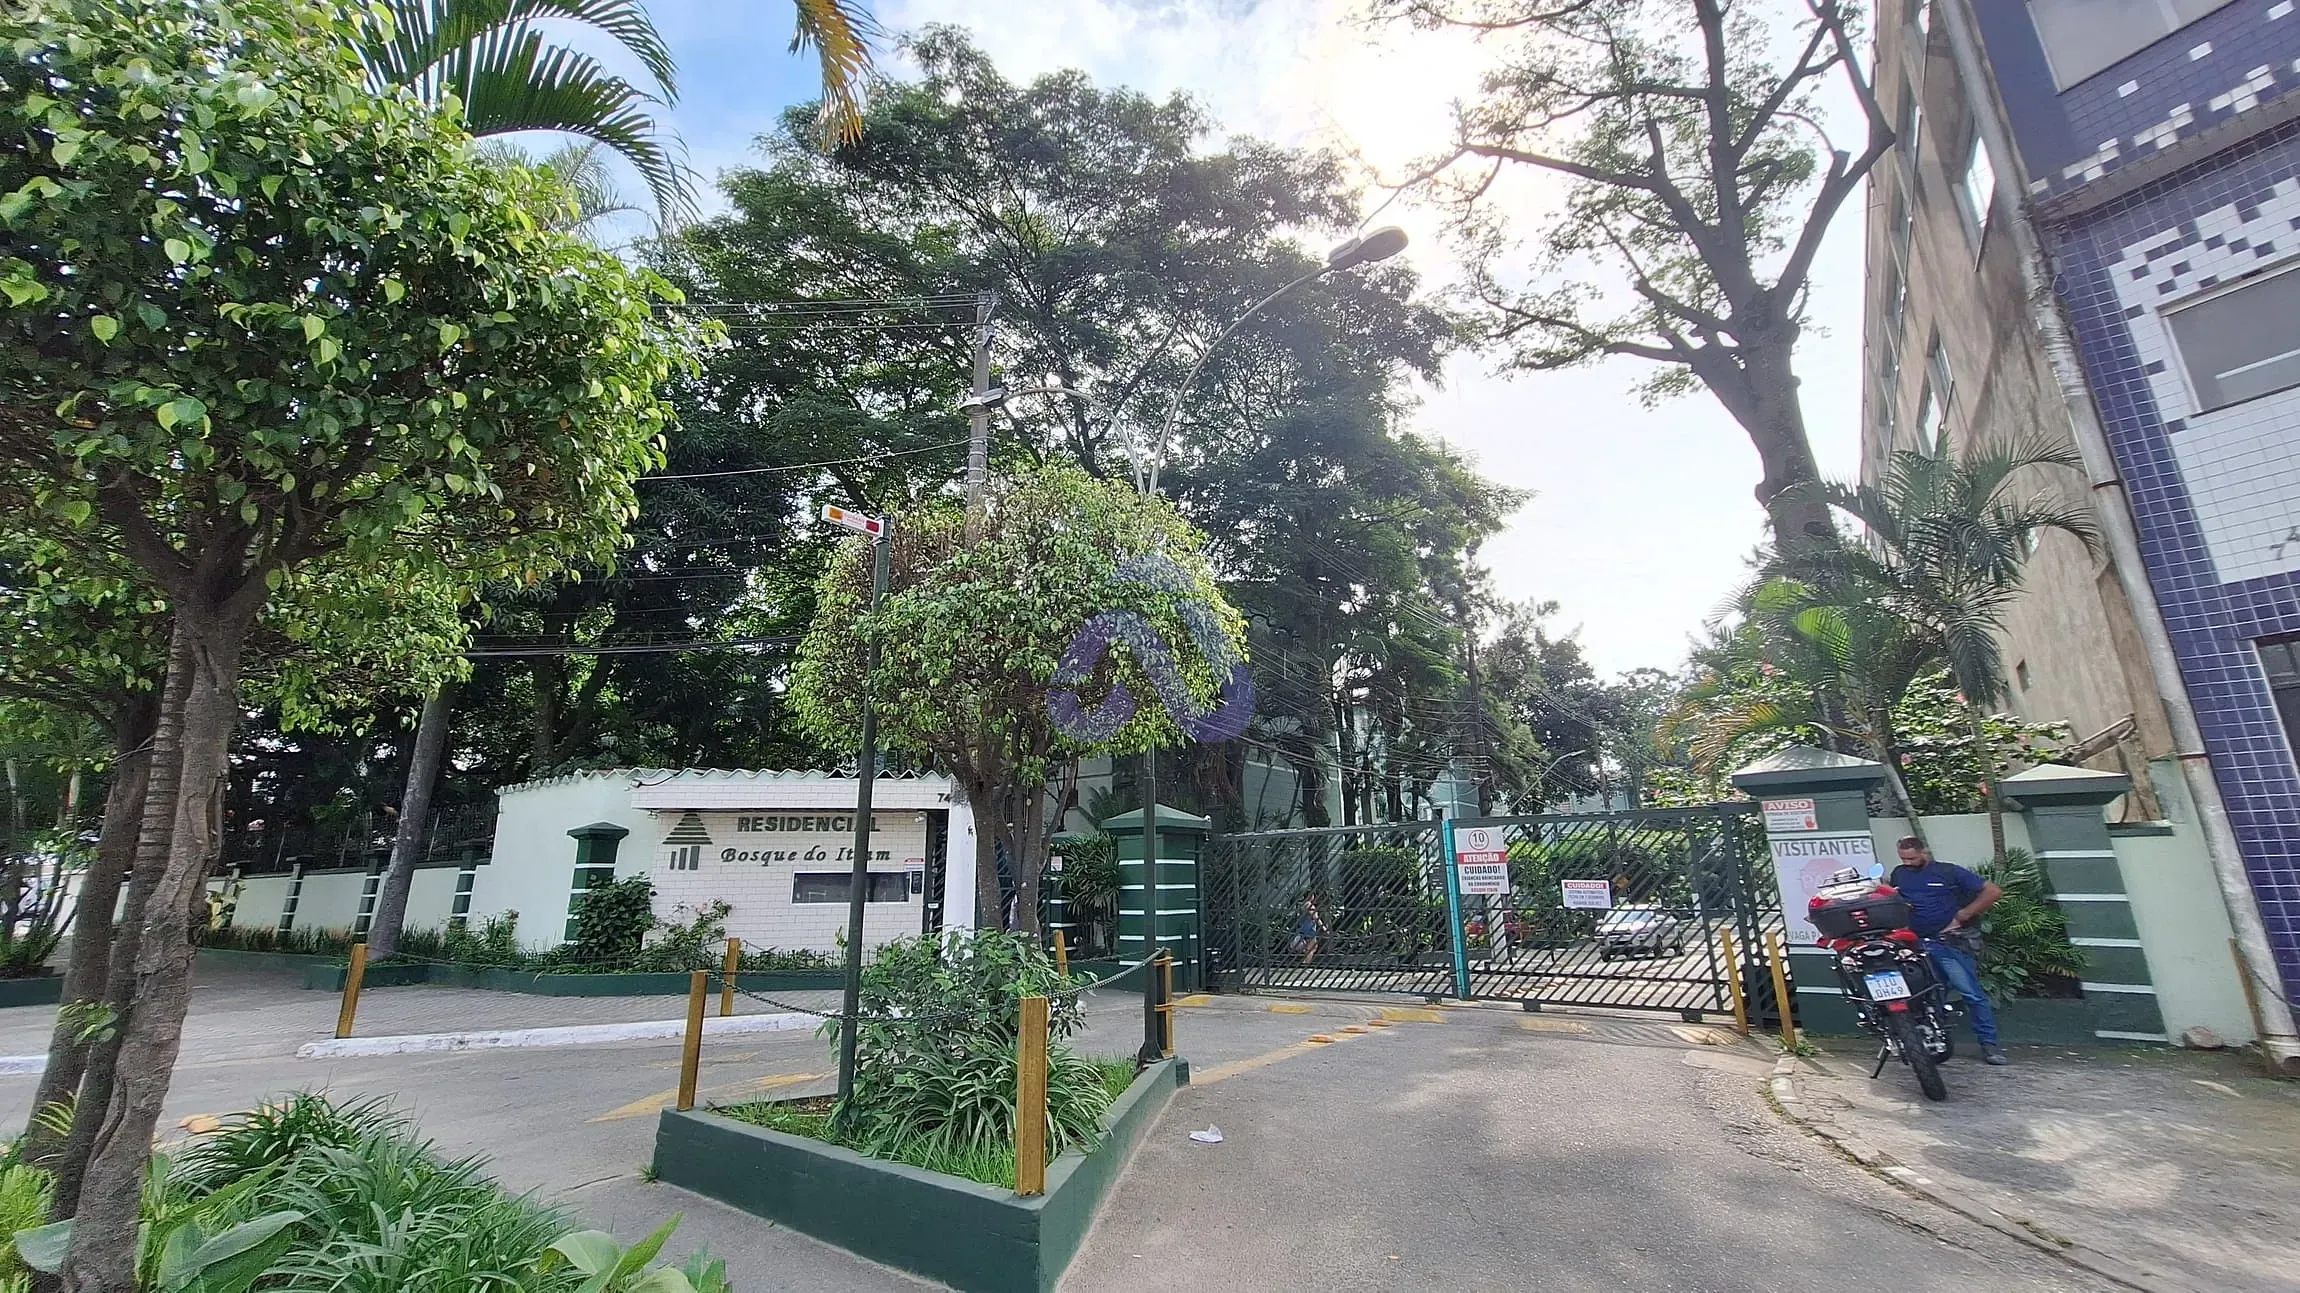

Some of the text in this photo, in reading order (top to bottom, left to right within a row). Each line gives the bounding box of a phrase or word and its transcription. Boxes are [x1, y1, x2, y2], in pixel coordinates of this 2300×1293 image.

[1768, 801, 1808, 810] AVISO
[737, 816, 881, 832] RESIDENCIL
[1472, 832, 1485, 843] 10
[1772, 838, 1871, 857] VISITANTES
[721, 847, 797, 867] Bosque
[803, 844, 827, 862] do
[1464, 853, 1499, 863] ATENÇÃO
[1464, 866, 1500, 874] CUIDADO!
